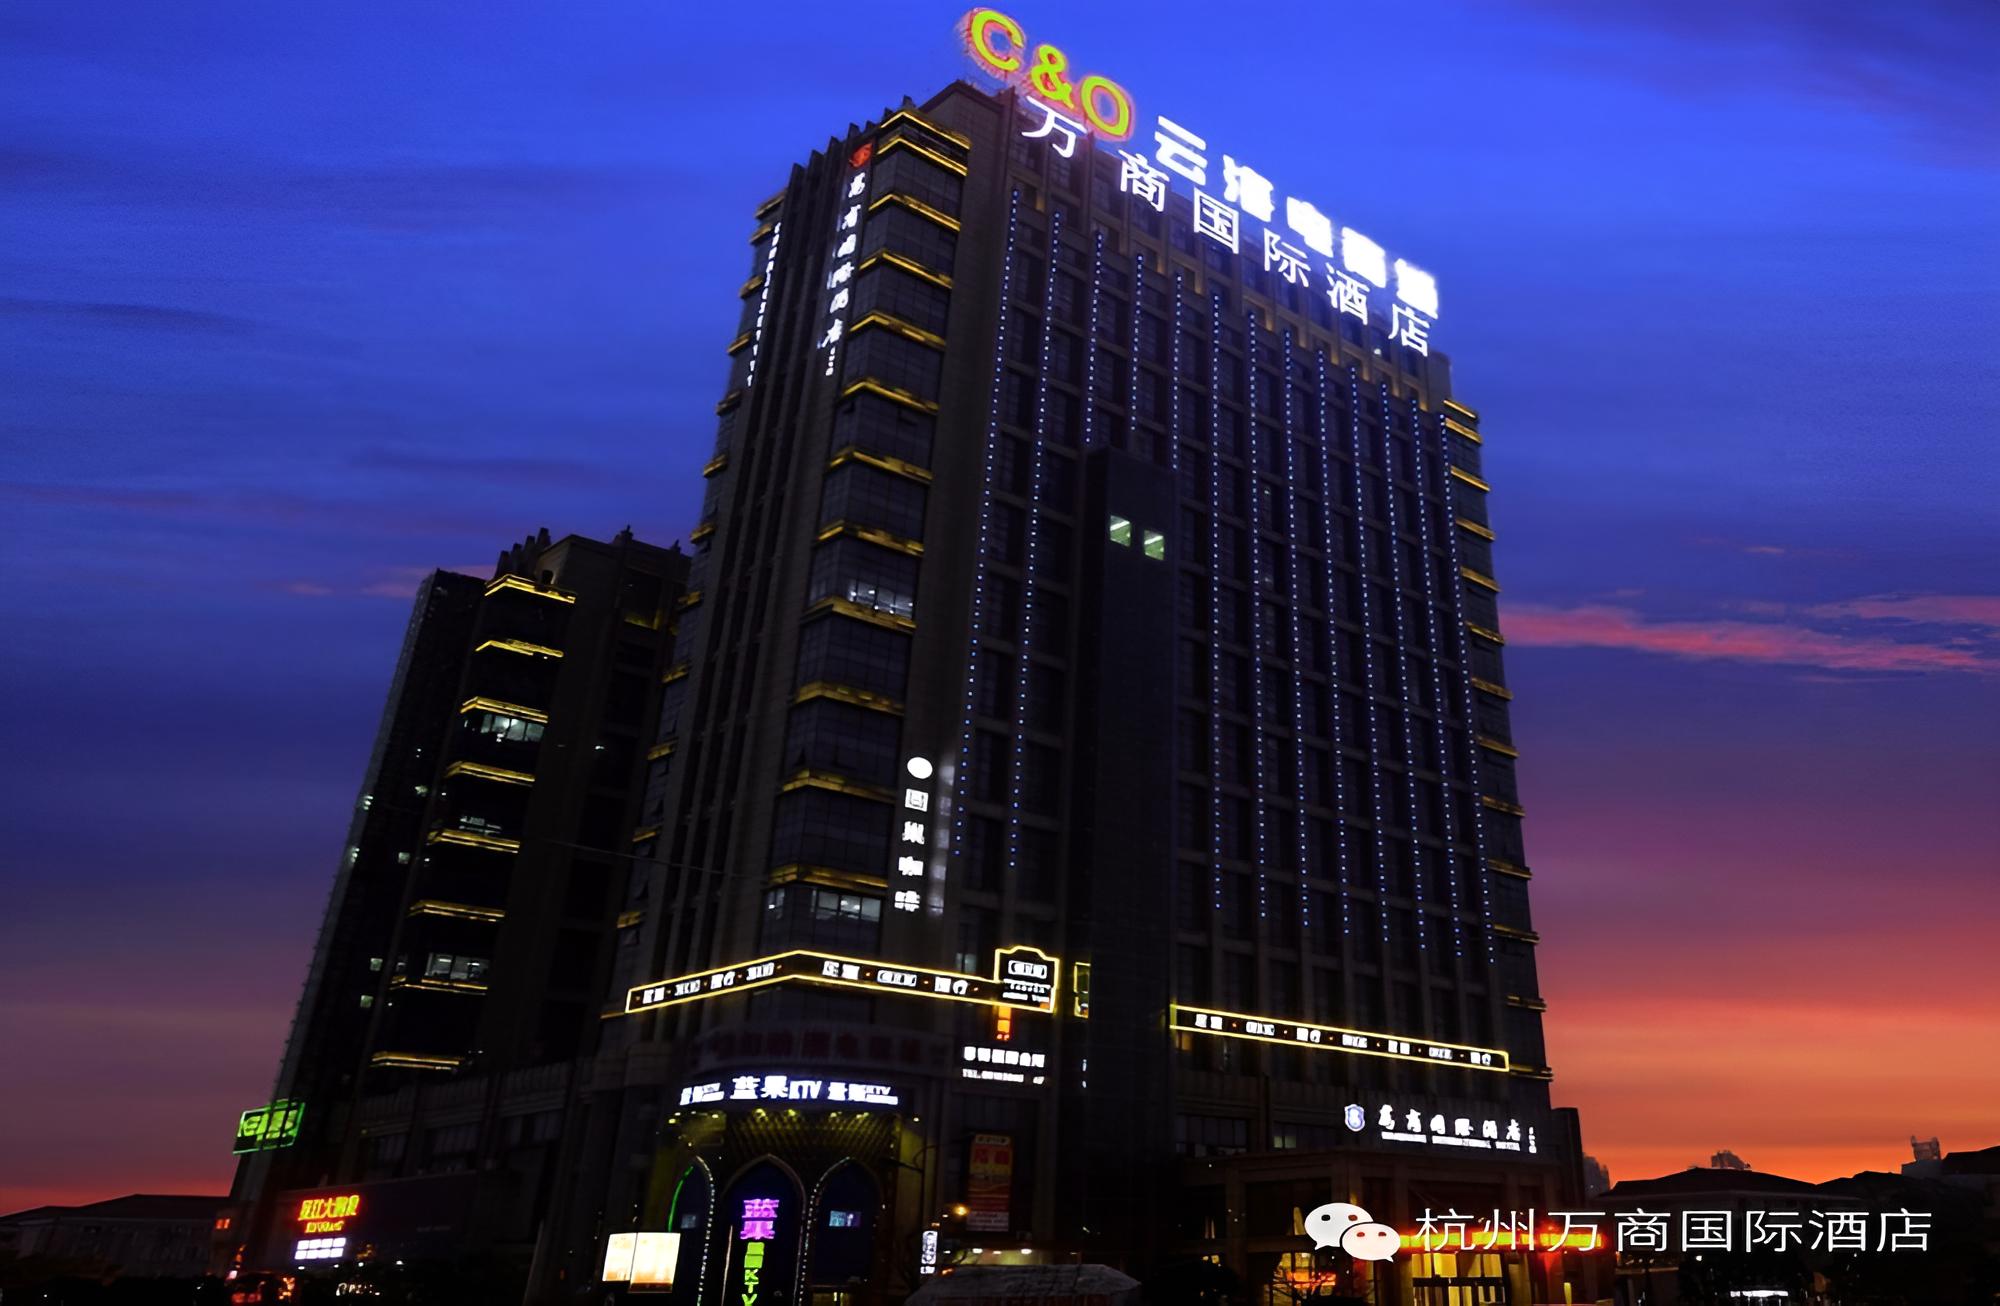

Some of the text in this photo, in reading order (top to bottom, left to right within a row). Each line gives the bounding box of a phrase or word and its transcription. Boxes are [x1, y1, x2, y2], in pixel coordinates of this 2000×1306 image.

[963, 8, 1133, 141] C&O
[1021, 95, 1430, 357] 万商国际酒店
